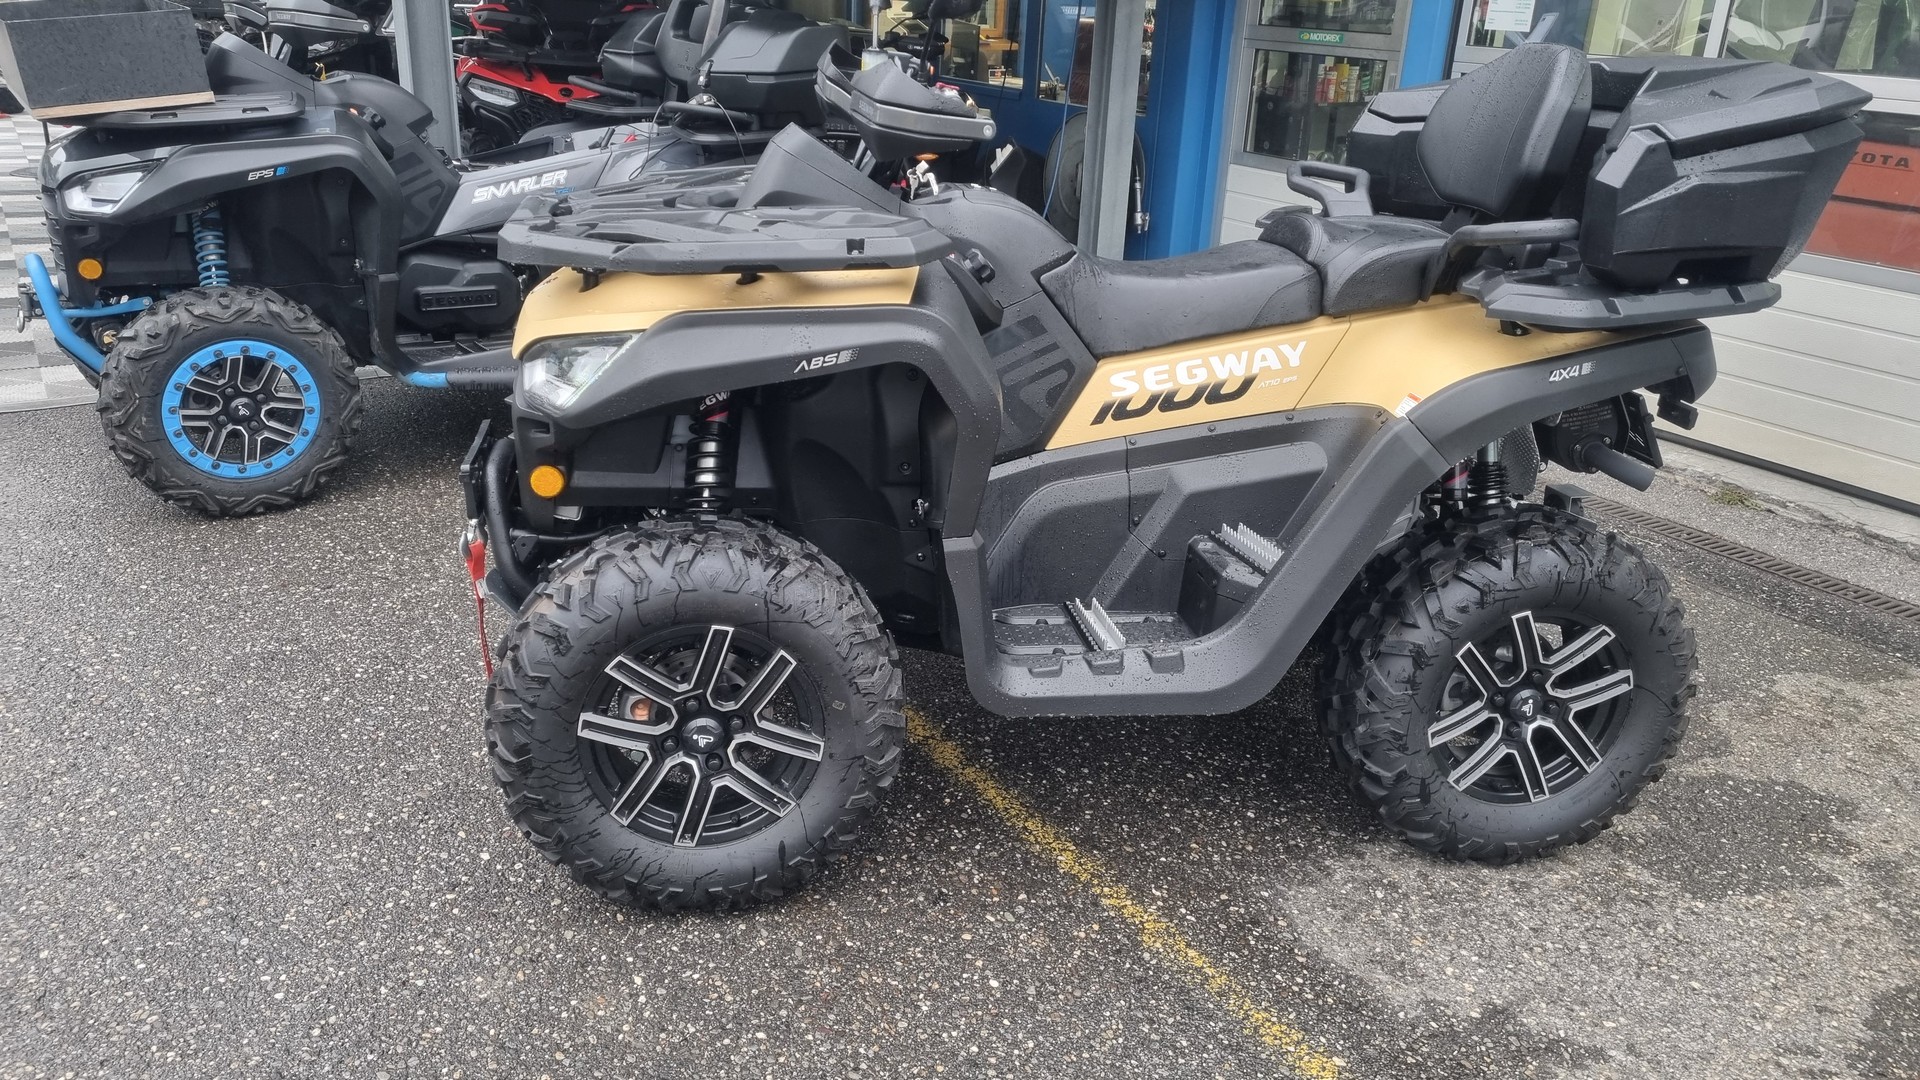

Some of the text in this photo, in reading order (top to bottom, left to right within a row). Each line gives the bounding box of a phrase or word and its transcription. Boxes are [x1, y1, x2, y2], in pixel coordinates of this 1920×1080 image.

[1309, 32, 1341, 43] MOTOREX
[247, 168, 275, 181] EPS
[471, 169, 569, 204] SNARLER
[793, 353, 839, 374] ABS
[1109, 341, 1307, 398] SEGWAY
[1548, 364, 1581, 382] 4X4
